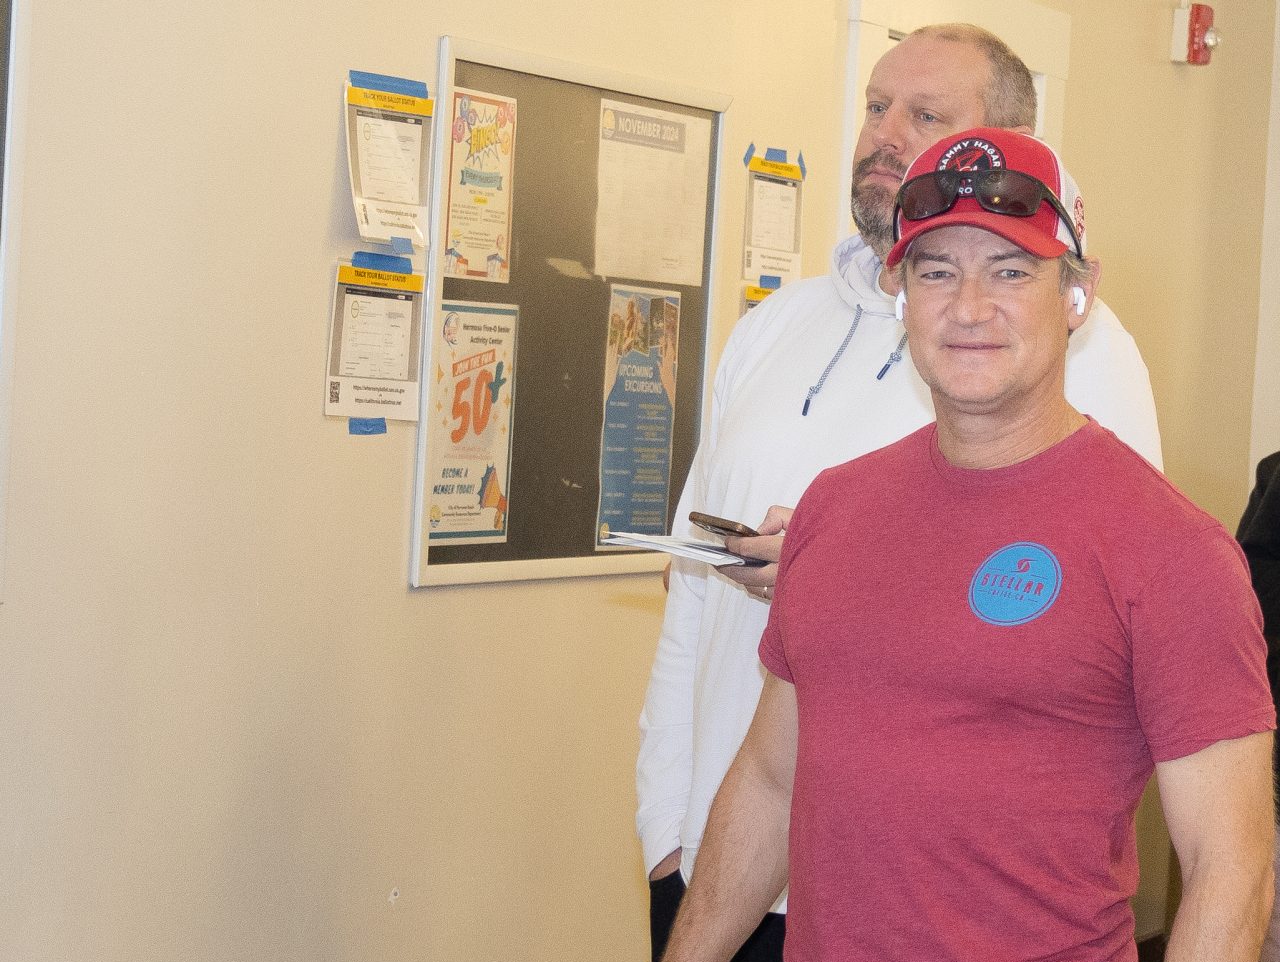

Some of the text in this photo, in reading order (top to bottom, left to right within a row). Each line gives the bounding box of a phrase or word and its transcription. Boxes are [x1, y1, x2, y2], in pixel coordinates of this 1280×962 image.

[618, 117, 661, 139] NOVEMBER
[939, 140, 1001, 171] SAMMY HAGAR
[354, 269, 406, 283] TRACK YOUR BALLOT STATUS
[470, 336, 503, 346] Activity Center
[619, 363, 654, 378] UPCOMING
[624, 379, 663, 394] EXCURSIONS
[441, 467, 469, 479] BECOME A
[432, 484, 476, 495] MEMBER TODAY!
[981, 572, 1045, 597] STELLAR
